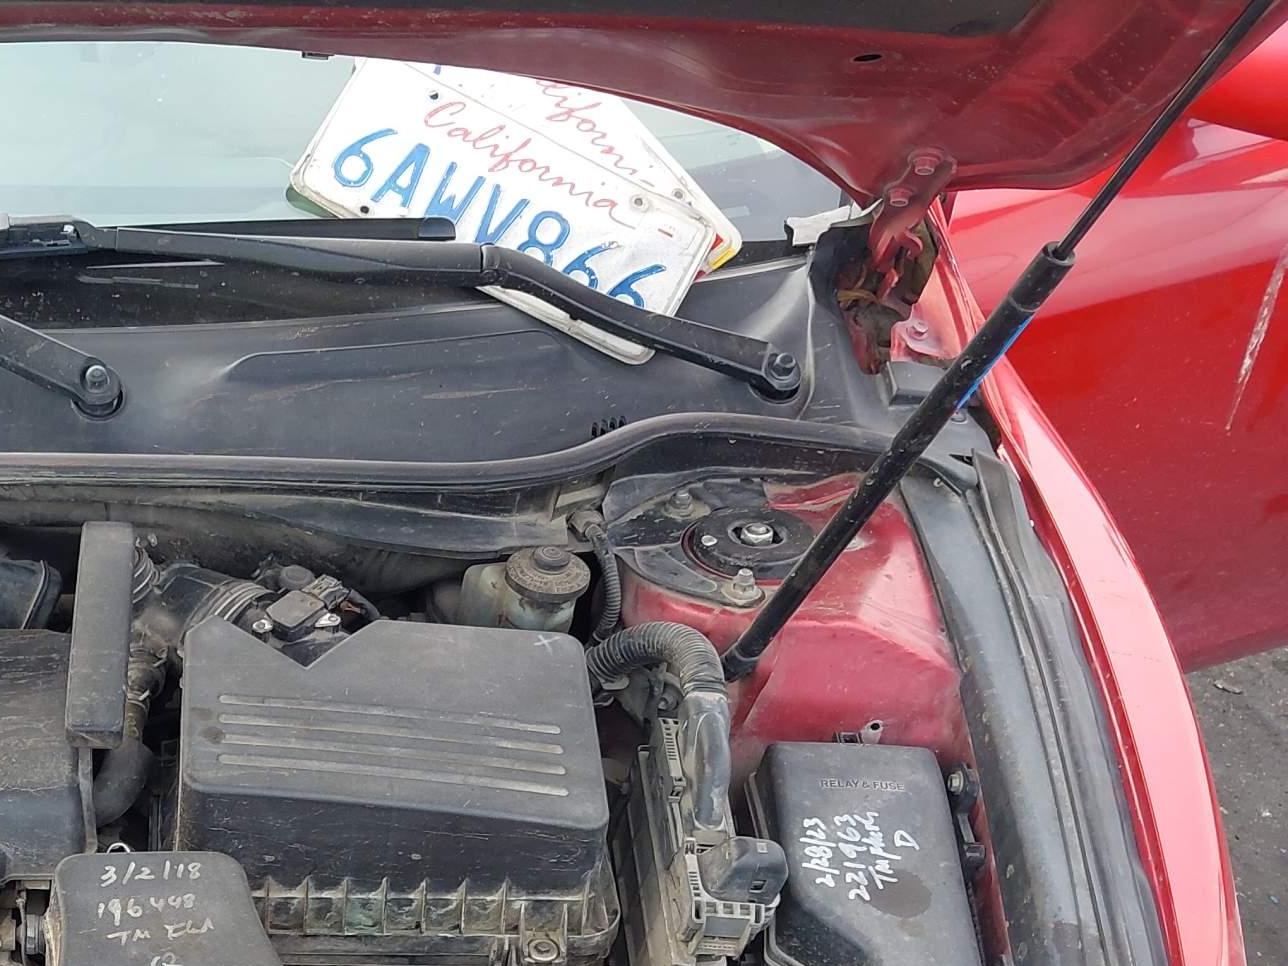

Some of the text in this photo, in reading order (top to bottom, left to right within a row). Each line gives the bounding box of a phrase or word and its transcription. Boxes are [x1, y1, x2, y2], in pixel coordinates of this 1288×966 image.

[331, 127, 667, 307] 6AWV866
[424, 101, 636, 229] California
[821, 779, 905, 791] RELAY & FUSE
